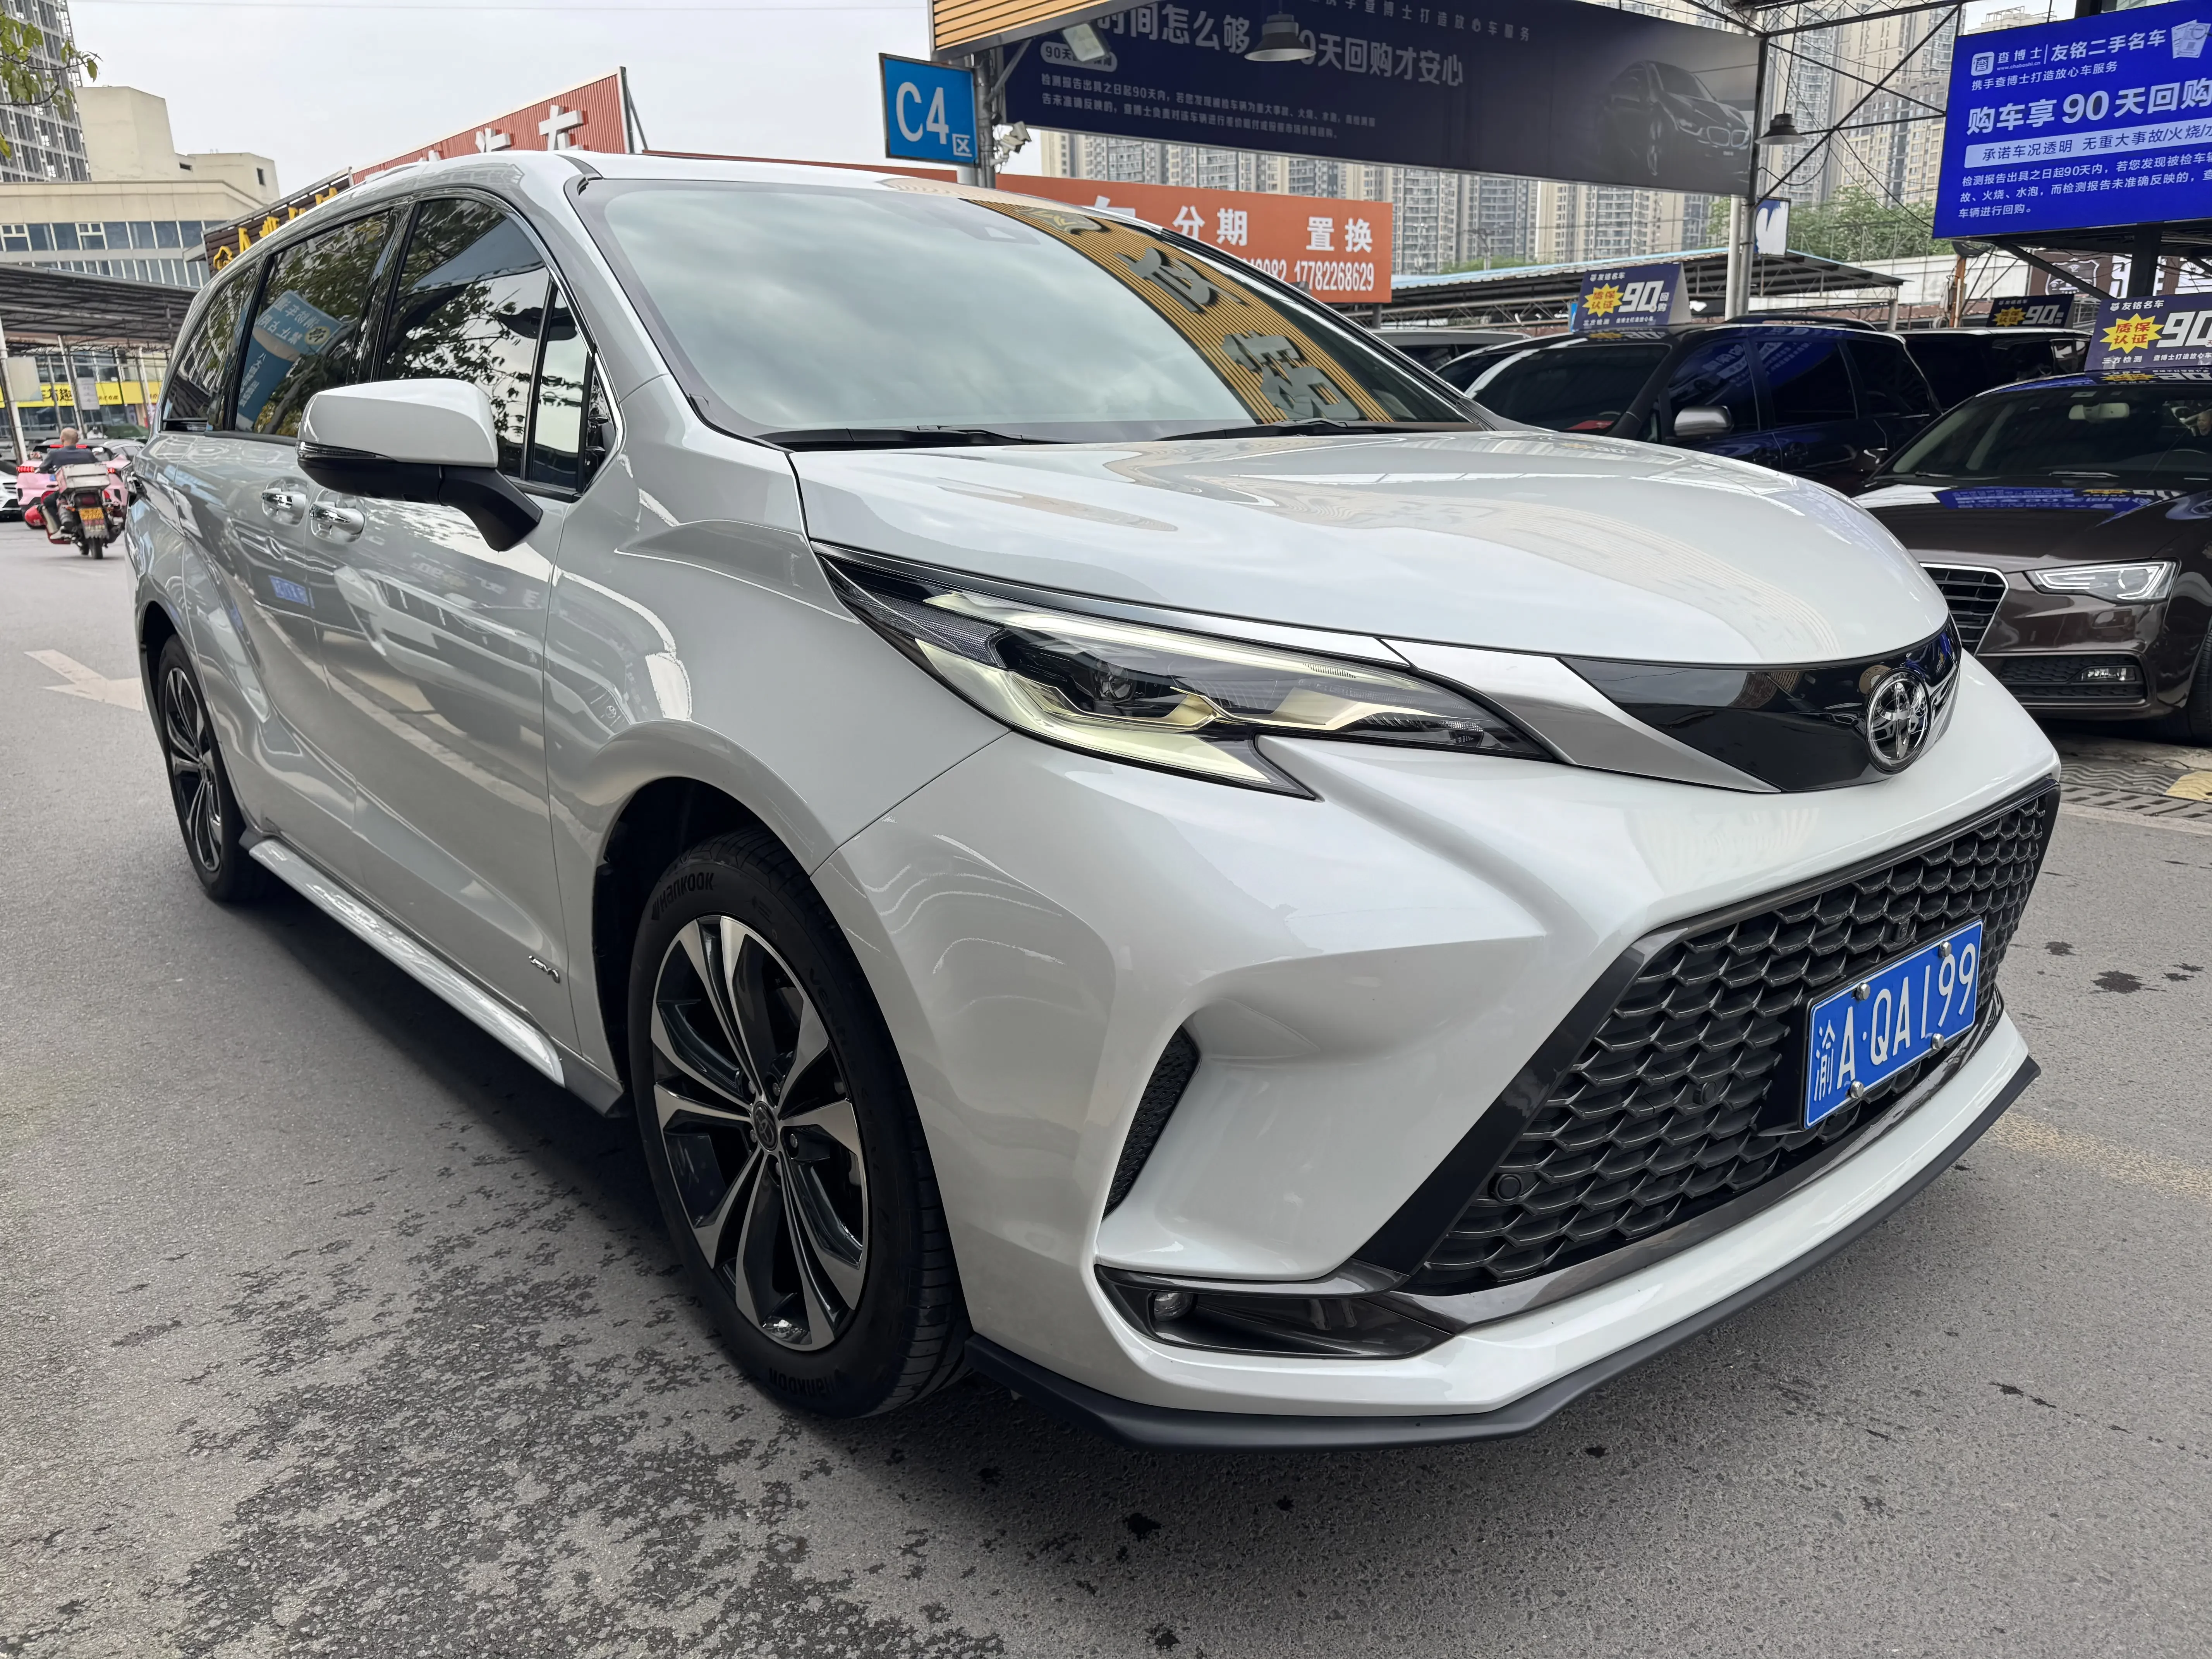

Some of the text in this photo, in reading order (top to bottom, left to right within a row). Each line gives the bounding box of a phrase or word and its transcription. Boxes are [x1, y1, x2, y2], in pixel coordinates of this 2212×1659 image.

[1997, 47, 2043, 64] 查博士
[2051, 29, 2167, 62] 友铭二手名车
[1972, 62, 2118, 91] 携手查博士打造放心车服务
[1996, 61, 2041, 70] www.chaboshi.cn
[1982, 139, 2073, 161] 承诺车况透明
[1294, 260, 1374, 292] 17782268629
[1618, 280, 1665, 313] 90
[2121, 299, 2165, 311] 友铭名车
[2116, 322, 2151, 333] 质保
[2114, 334, 2148, 345] 认证
[2102, 355, 2143, 365] 三方检测
[1814, 943, 1976, 1101] 渝A·QA199
